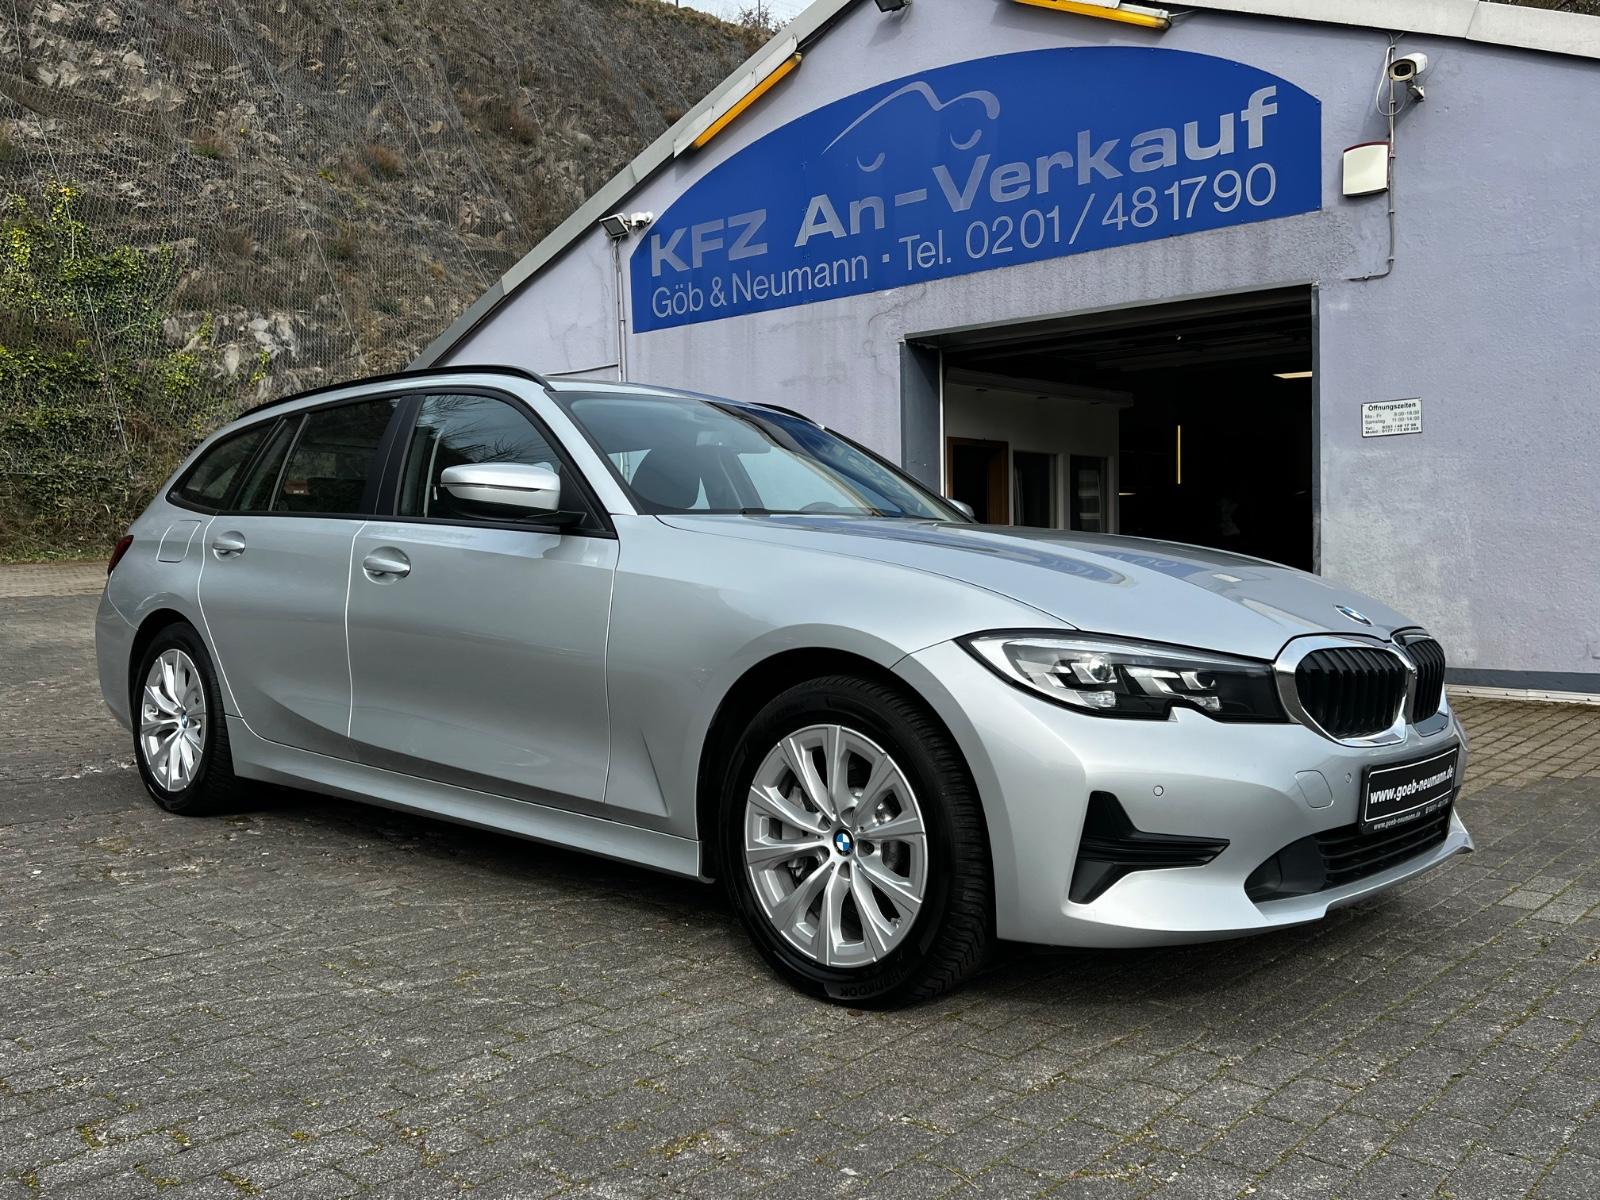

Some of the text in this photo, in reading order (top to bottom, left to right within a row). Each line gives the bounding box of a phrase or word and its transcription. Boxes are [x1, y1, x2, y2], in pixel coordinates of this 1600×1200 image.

[650, 208, 768, 278] KFZ
[652, 279, 703, 318] Göb
[710, 280, 727, 307] &
[733, 254, 868, 304] Neumann
[898, 229, 952, 271] Tel.
[1368, 402, 1416, 411] Öffnungszeiten
[1370, 765, 1453, 804] www.goeb-neumann.de
